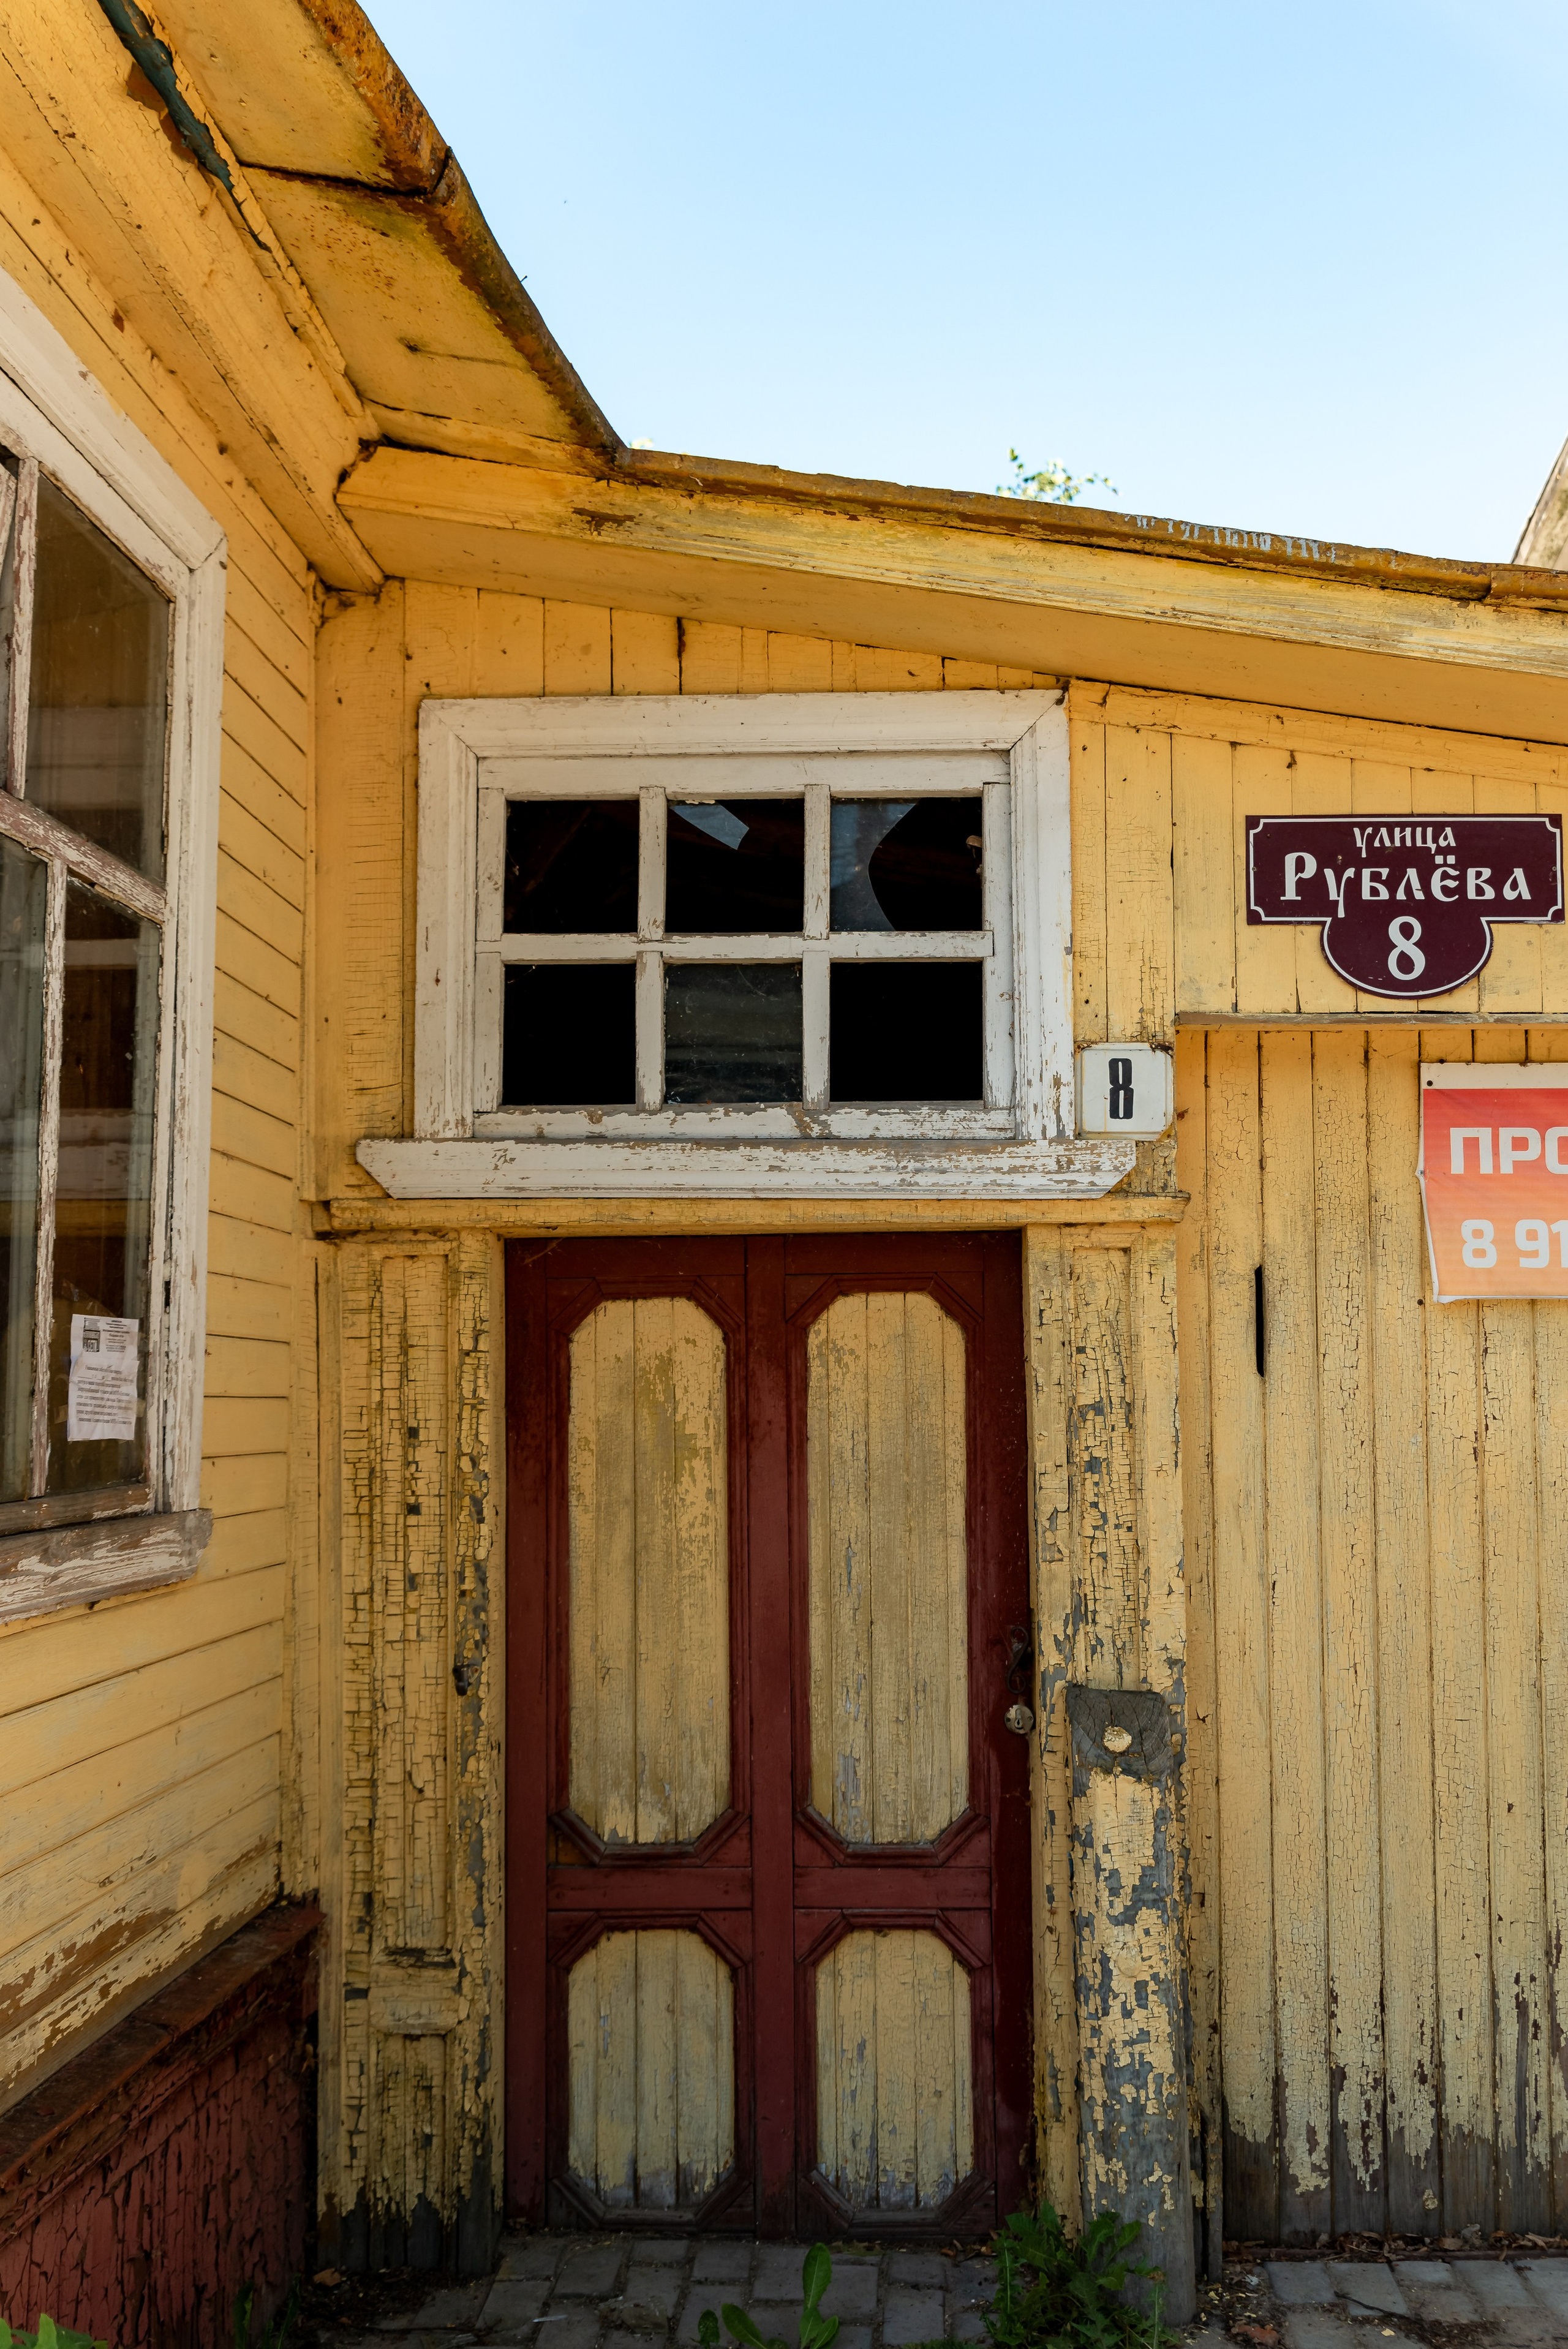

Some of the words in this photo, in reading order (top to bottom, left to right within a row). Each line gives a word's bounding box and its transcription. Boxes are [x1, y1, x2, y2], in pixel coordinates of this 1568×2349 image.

[1387, 916, 1426, 980] 8
[1108, 1058, 1134, 1119] 8
[1461, 1219, 1497, 1269] 8
